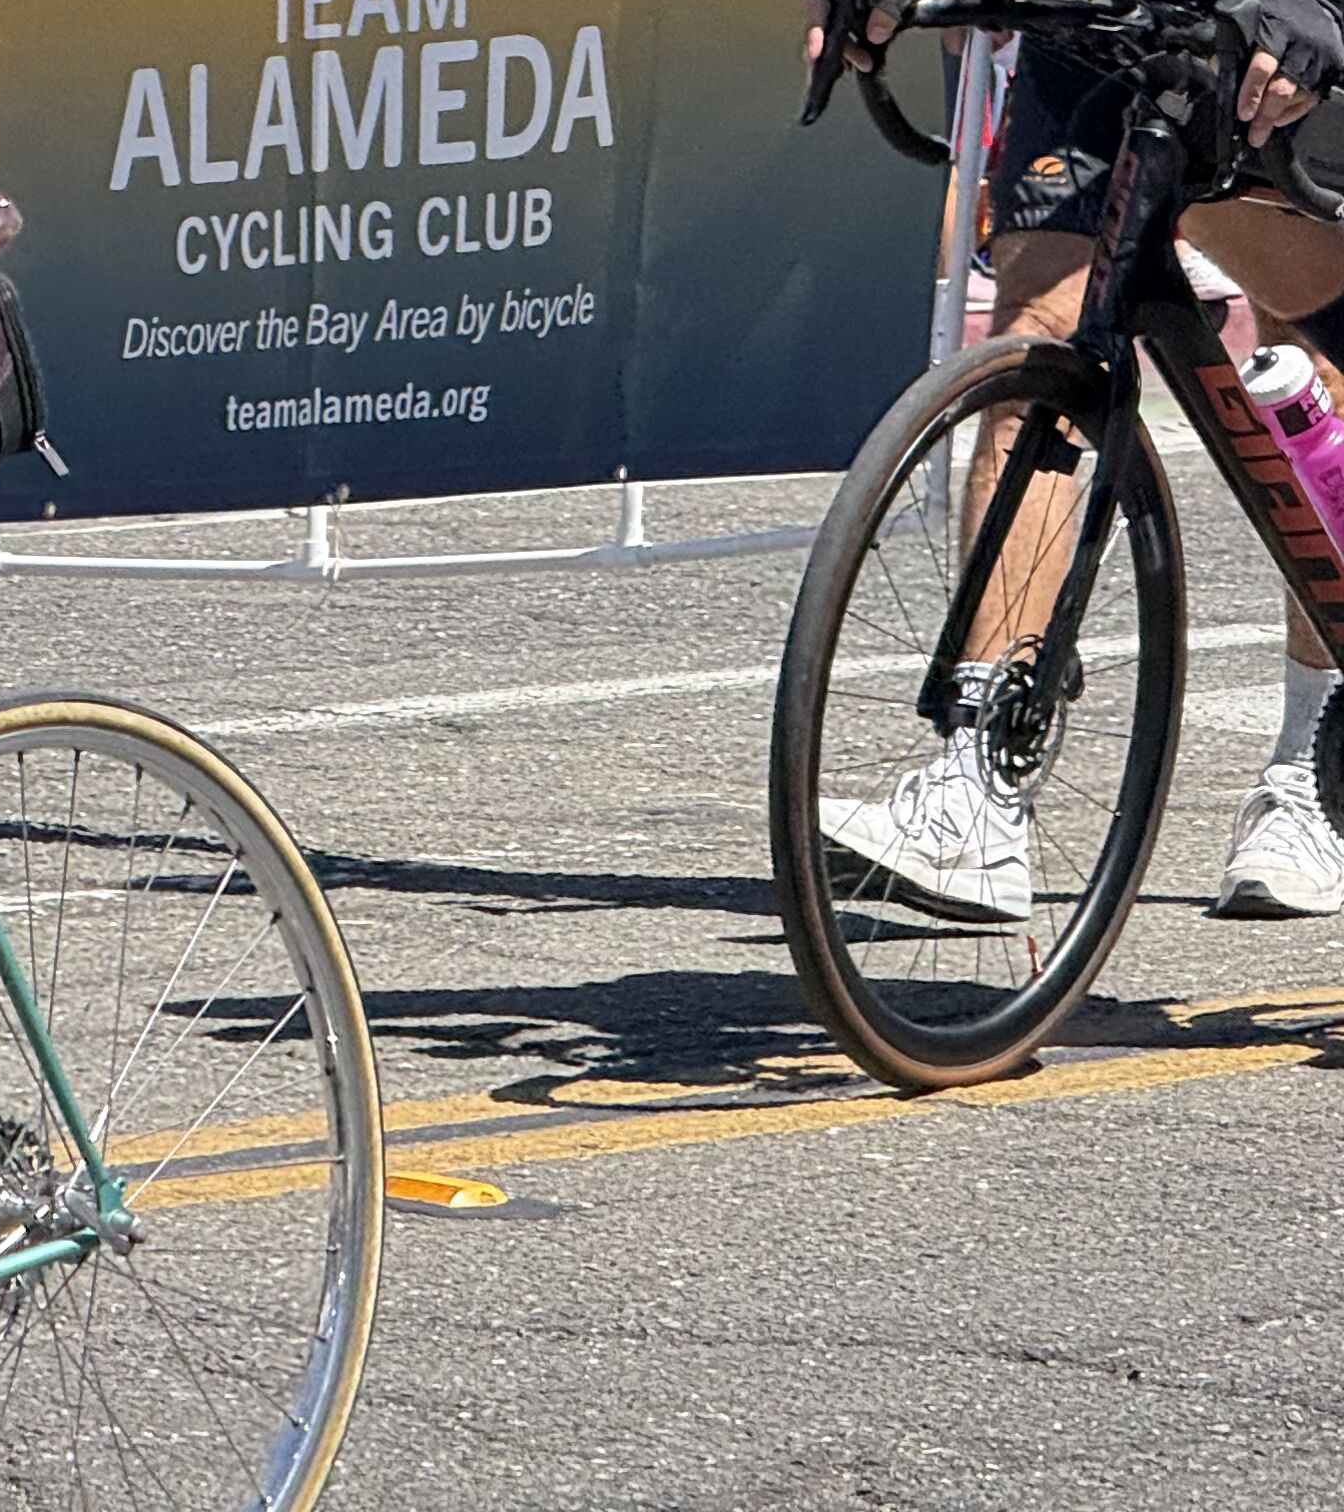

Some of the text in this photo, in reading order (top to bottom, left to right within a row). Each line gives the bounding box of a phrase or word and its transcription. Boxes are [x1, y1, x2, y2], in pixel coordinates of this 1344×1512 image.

[110, 26, 613, 191] ALAMEDA
[176, 188, 553, 275] CYCLING CLUB
[122, 284, 595, 360] Discover the Bay Area by bicycle
[225, 383, 491, 431] teamalameda.org
[1195, 362, 1344, 648] GIAN
